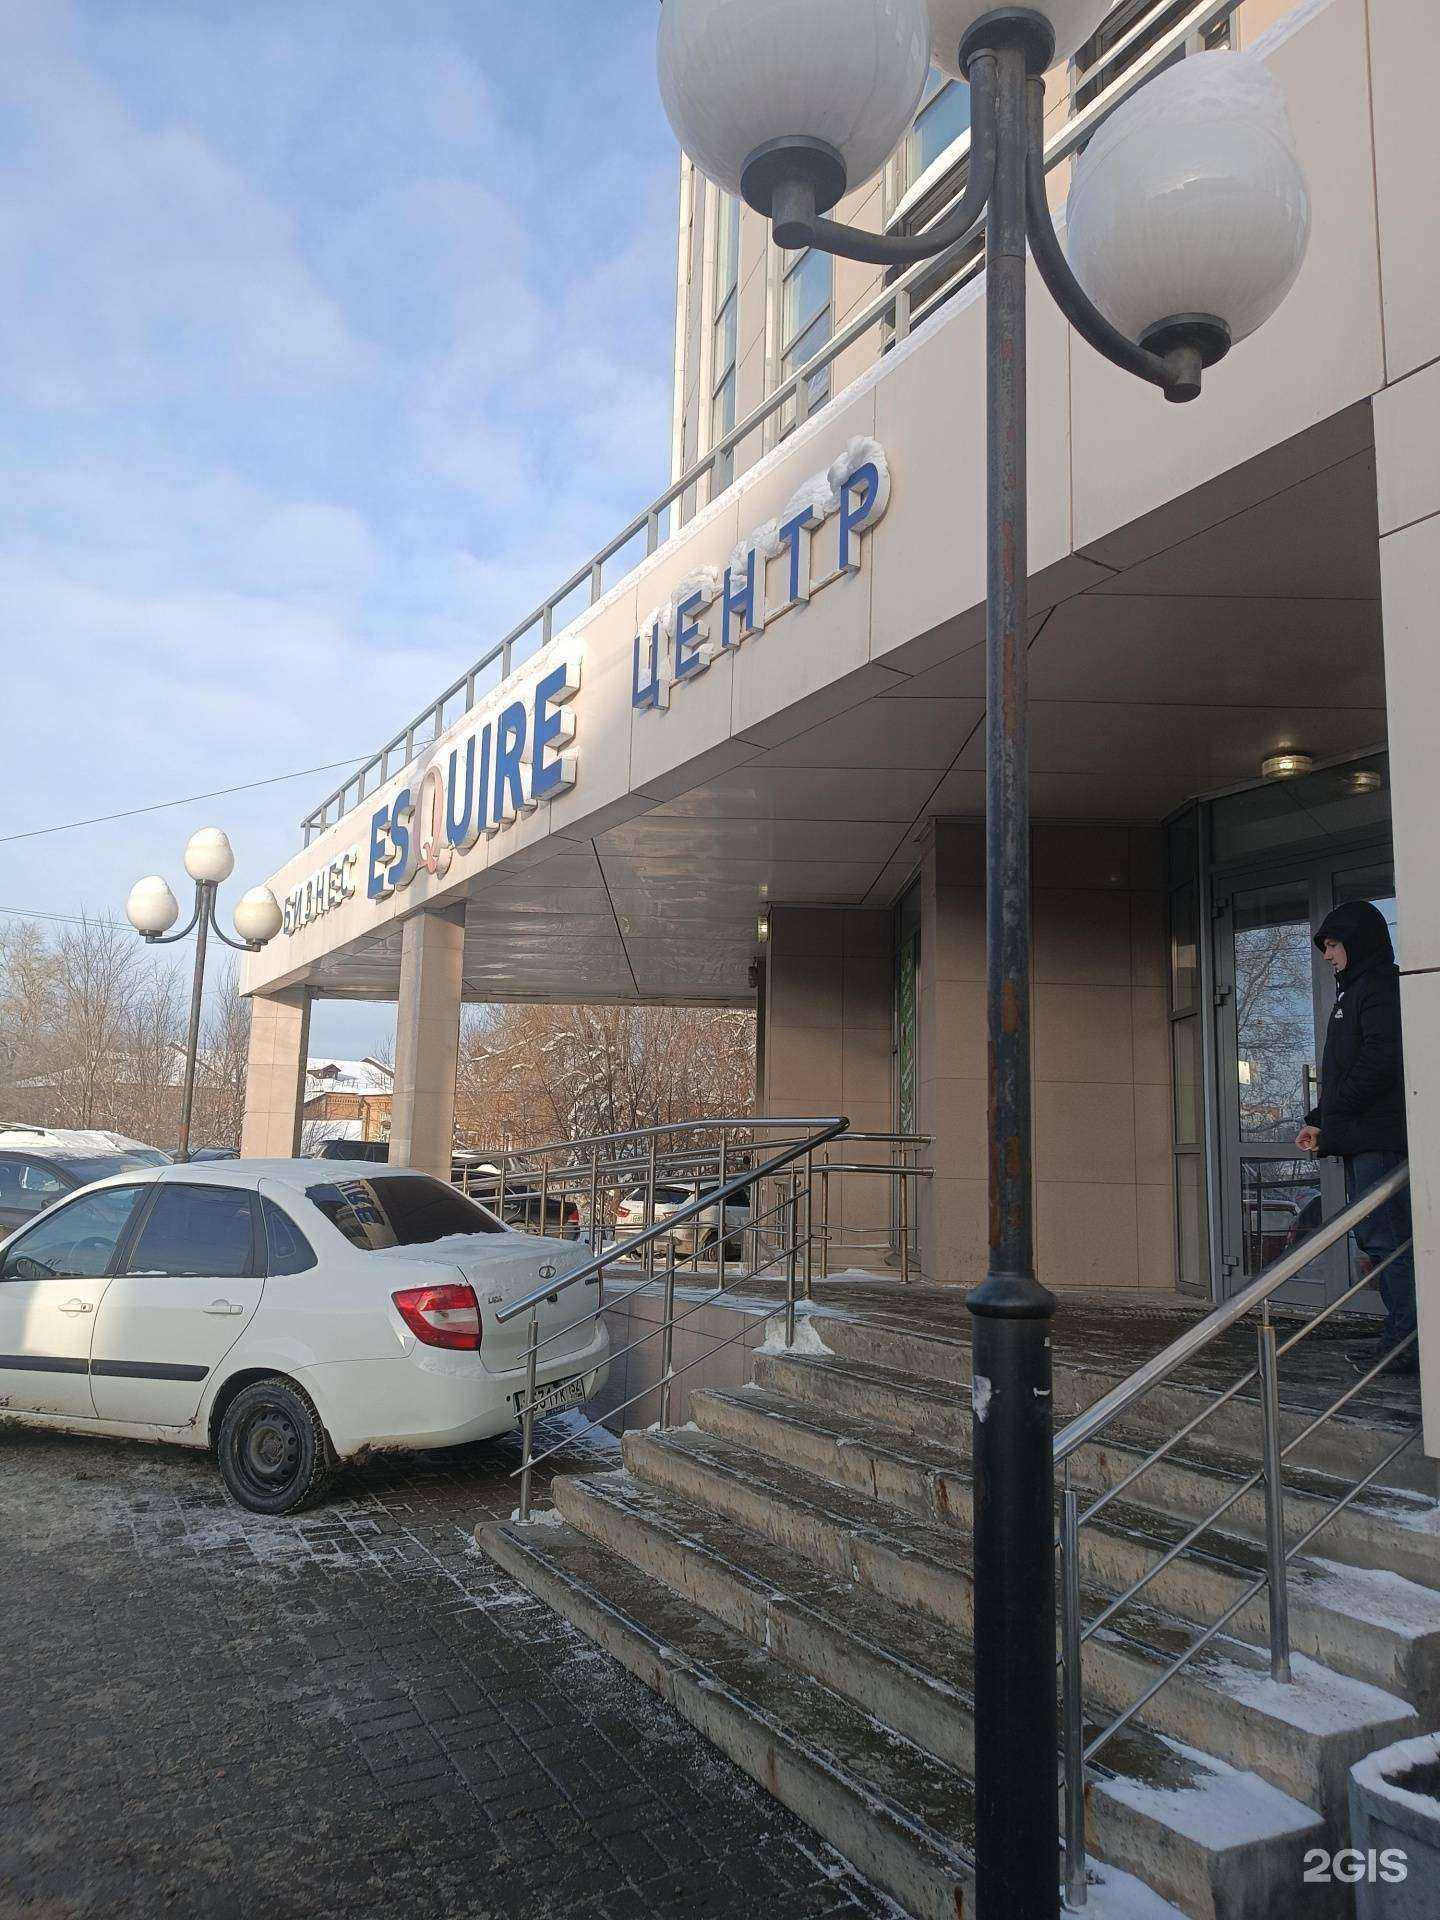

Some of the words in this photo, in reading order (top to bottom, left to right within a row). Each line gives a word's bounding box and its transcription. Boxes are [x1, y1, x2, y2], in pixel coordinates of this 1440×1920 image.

[283, 852, 356, 936] БИЗНЕС
[367, 662, 577, 901] ESQUIRE
[631, 461, 886, 710] ЦЕНТР
